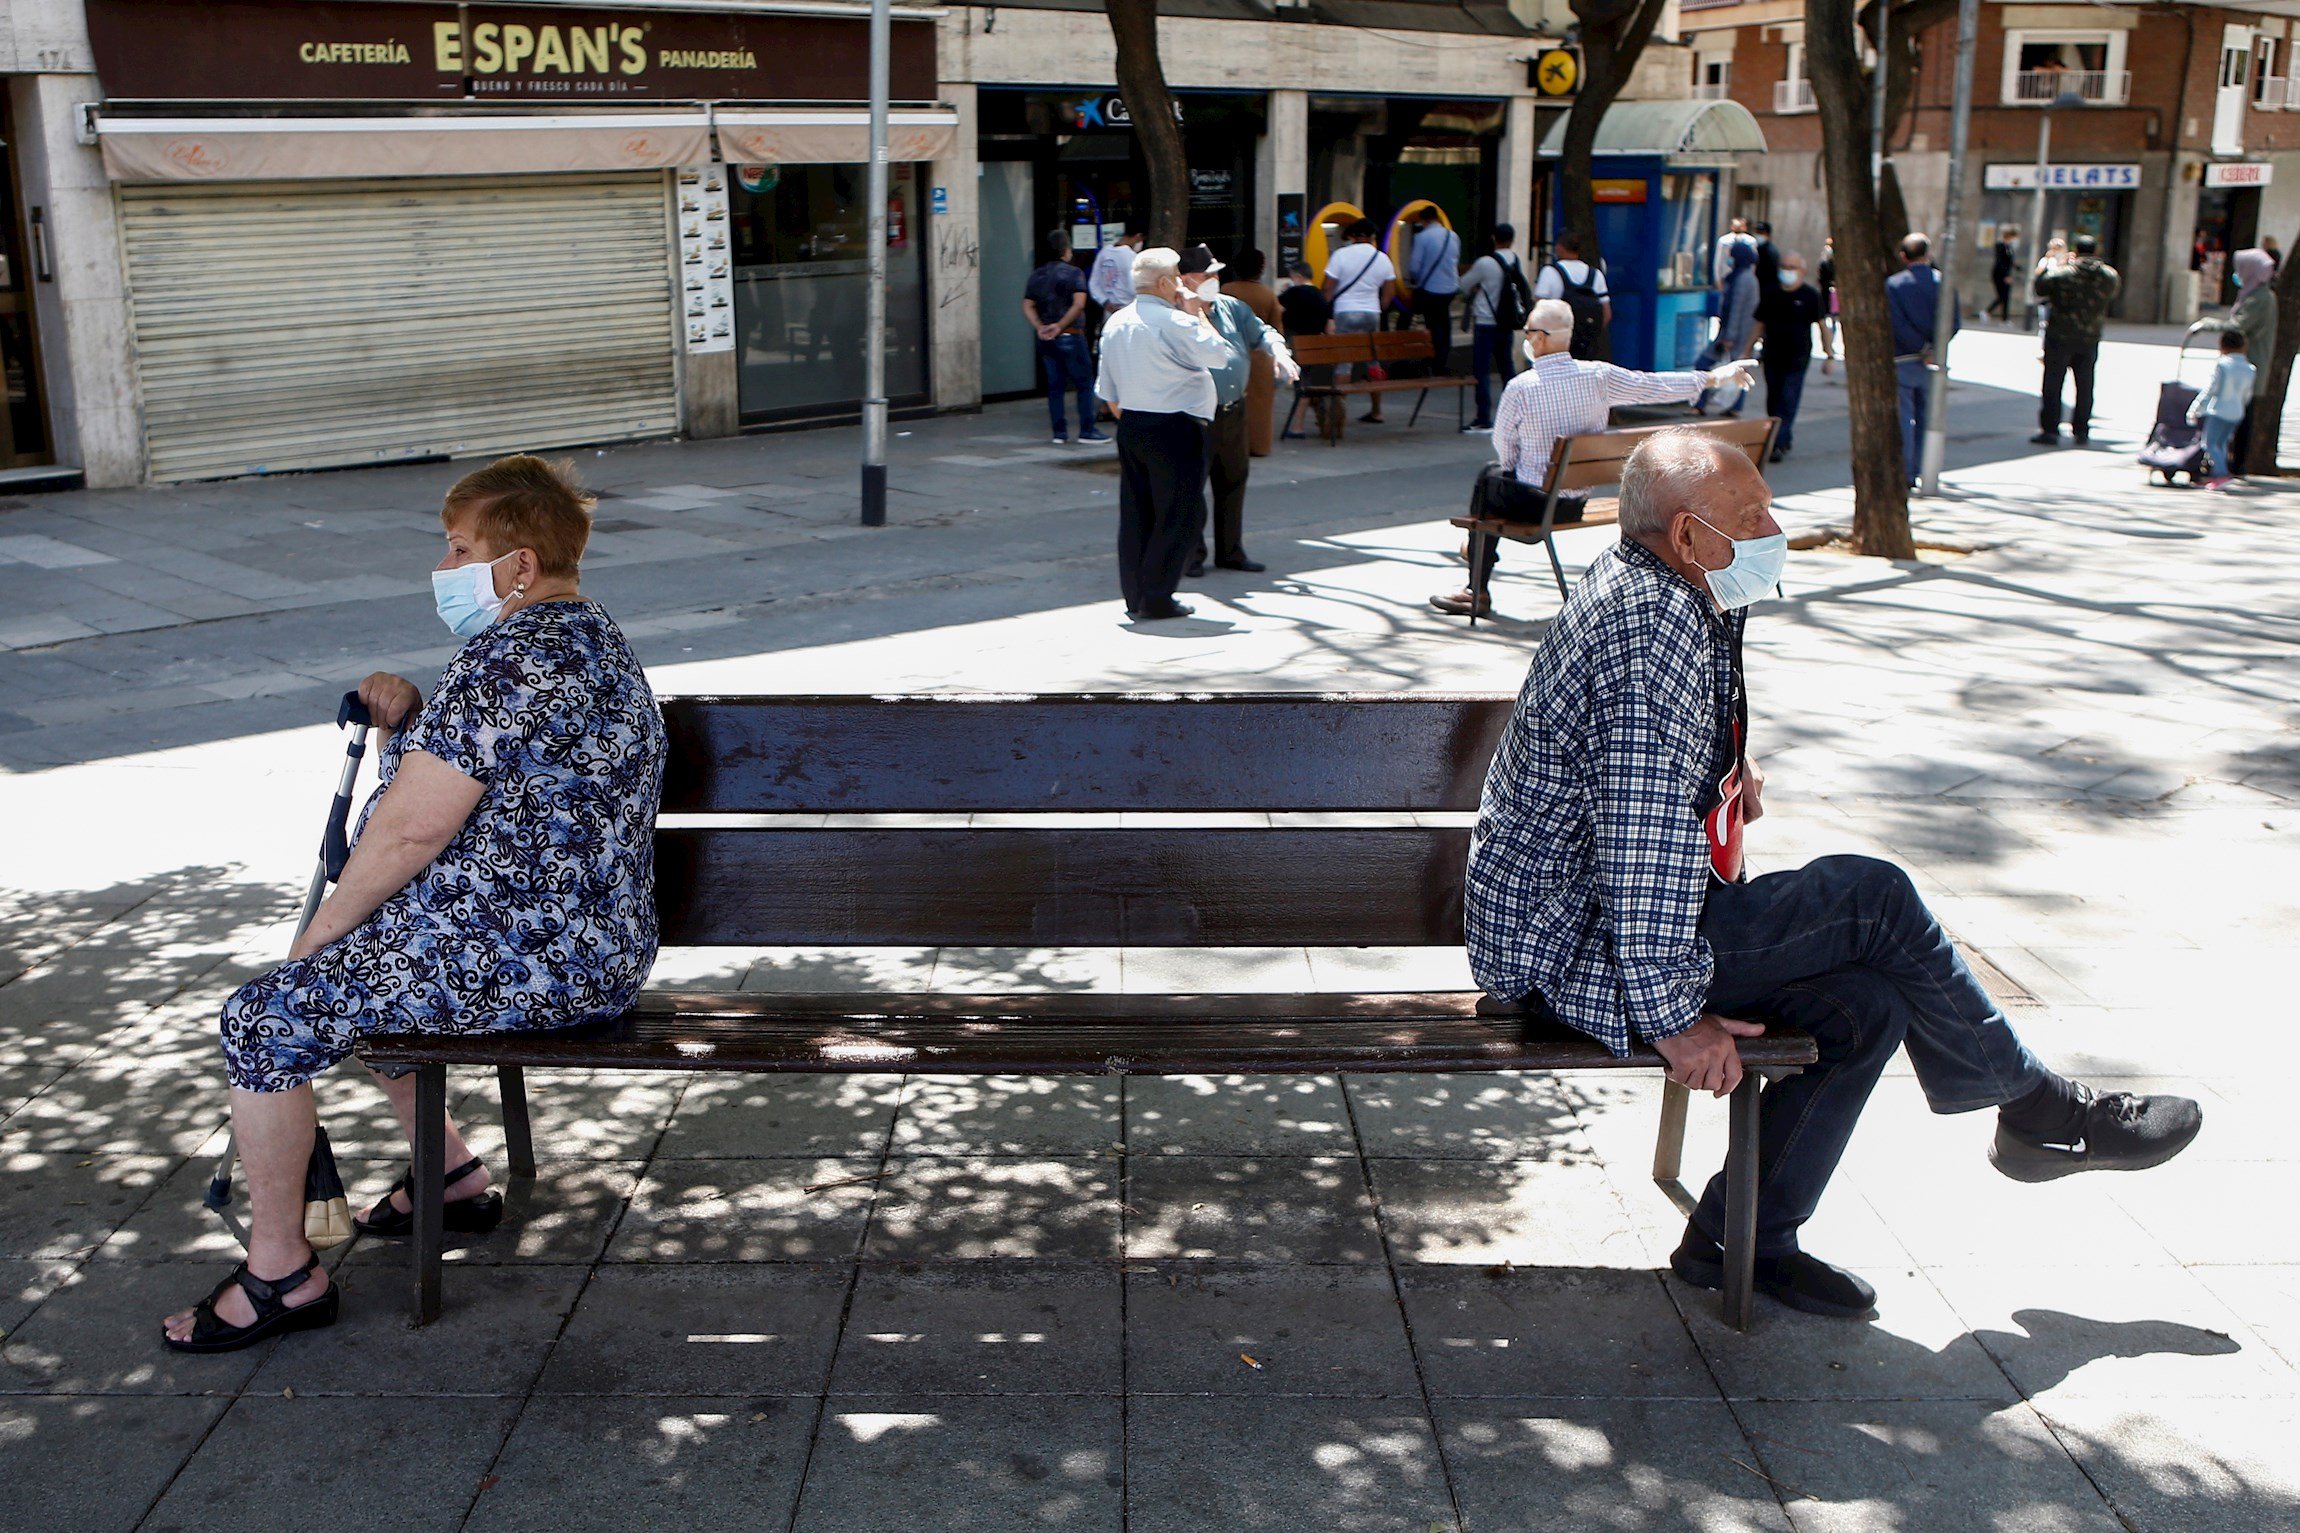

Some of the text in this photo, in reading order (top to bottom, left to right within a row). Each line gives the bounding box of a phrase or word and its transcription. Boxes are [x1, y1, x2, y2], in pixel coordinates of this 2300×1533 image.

[299, 38, 411, 64] CAFETERÍA
[433, 21, 648, 75] ESPAN'S
[659, 46, 757, 69] PANADERÍA
[472, 79, 629, 93] BUENO Y FRESCO CADA DÍA
